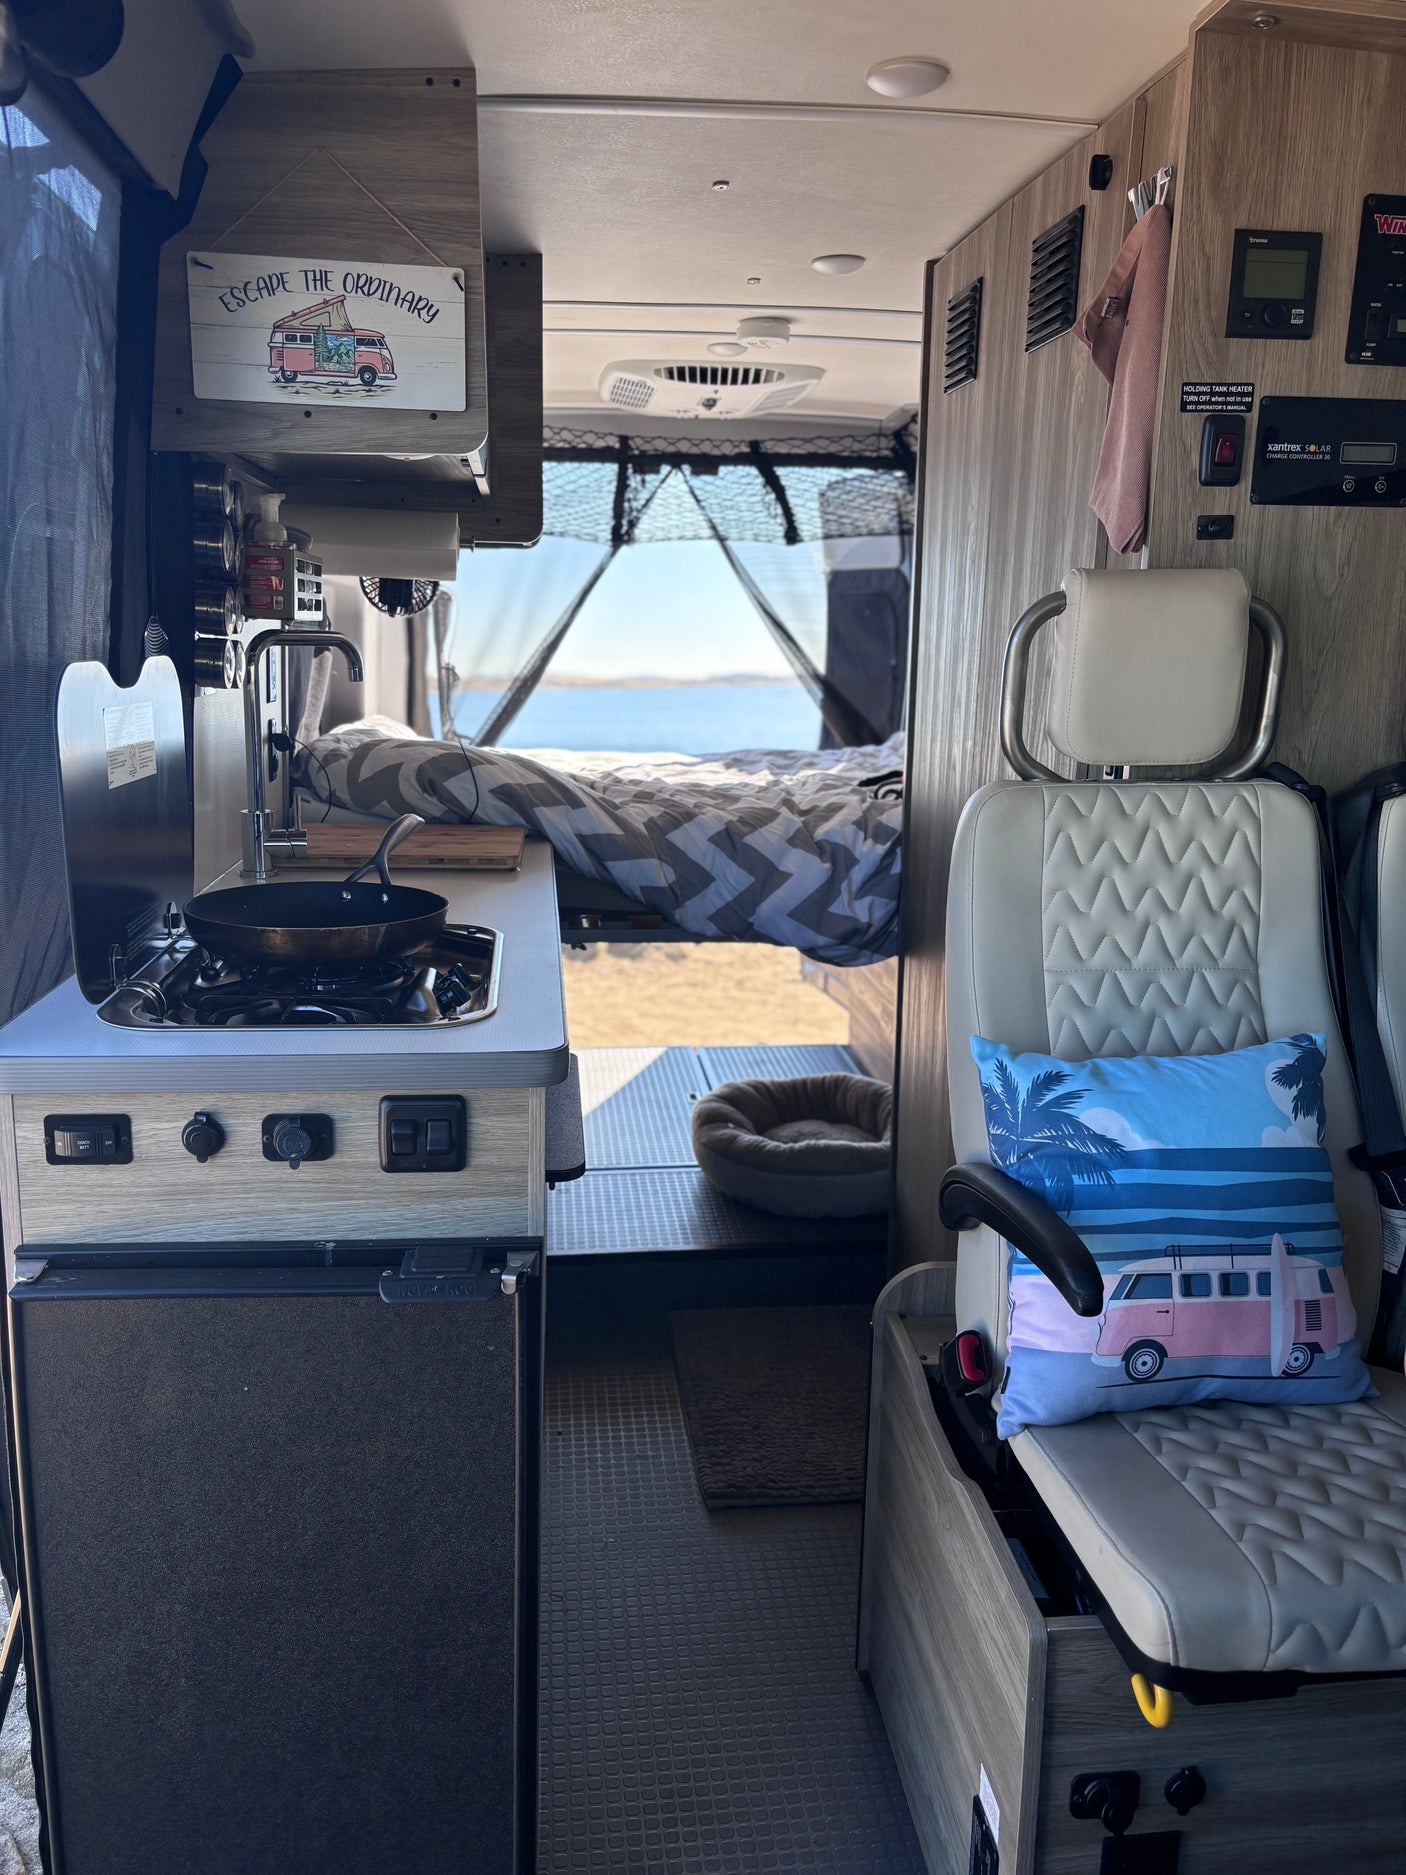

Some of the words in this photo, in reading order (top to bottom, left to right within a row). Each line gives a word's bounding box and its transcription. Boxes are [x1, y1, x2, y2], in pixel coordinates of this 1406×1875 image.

[218, 271, 293, 313] ESCAPE
[298, 269, 335, 292] THE
[342, 271, 440, 324] ORDINARY
[1183, 385, 1211, 393] HOLDING
[1212, 385, 1228, 393] TANK
[1267, 443, 1301, 452] xantrex
[1305, 444, 1331, 453] SOLAR
